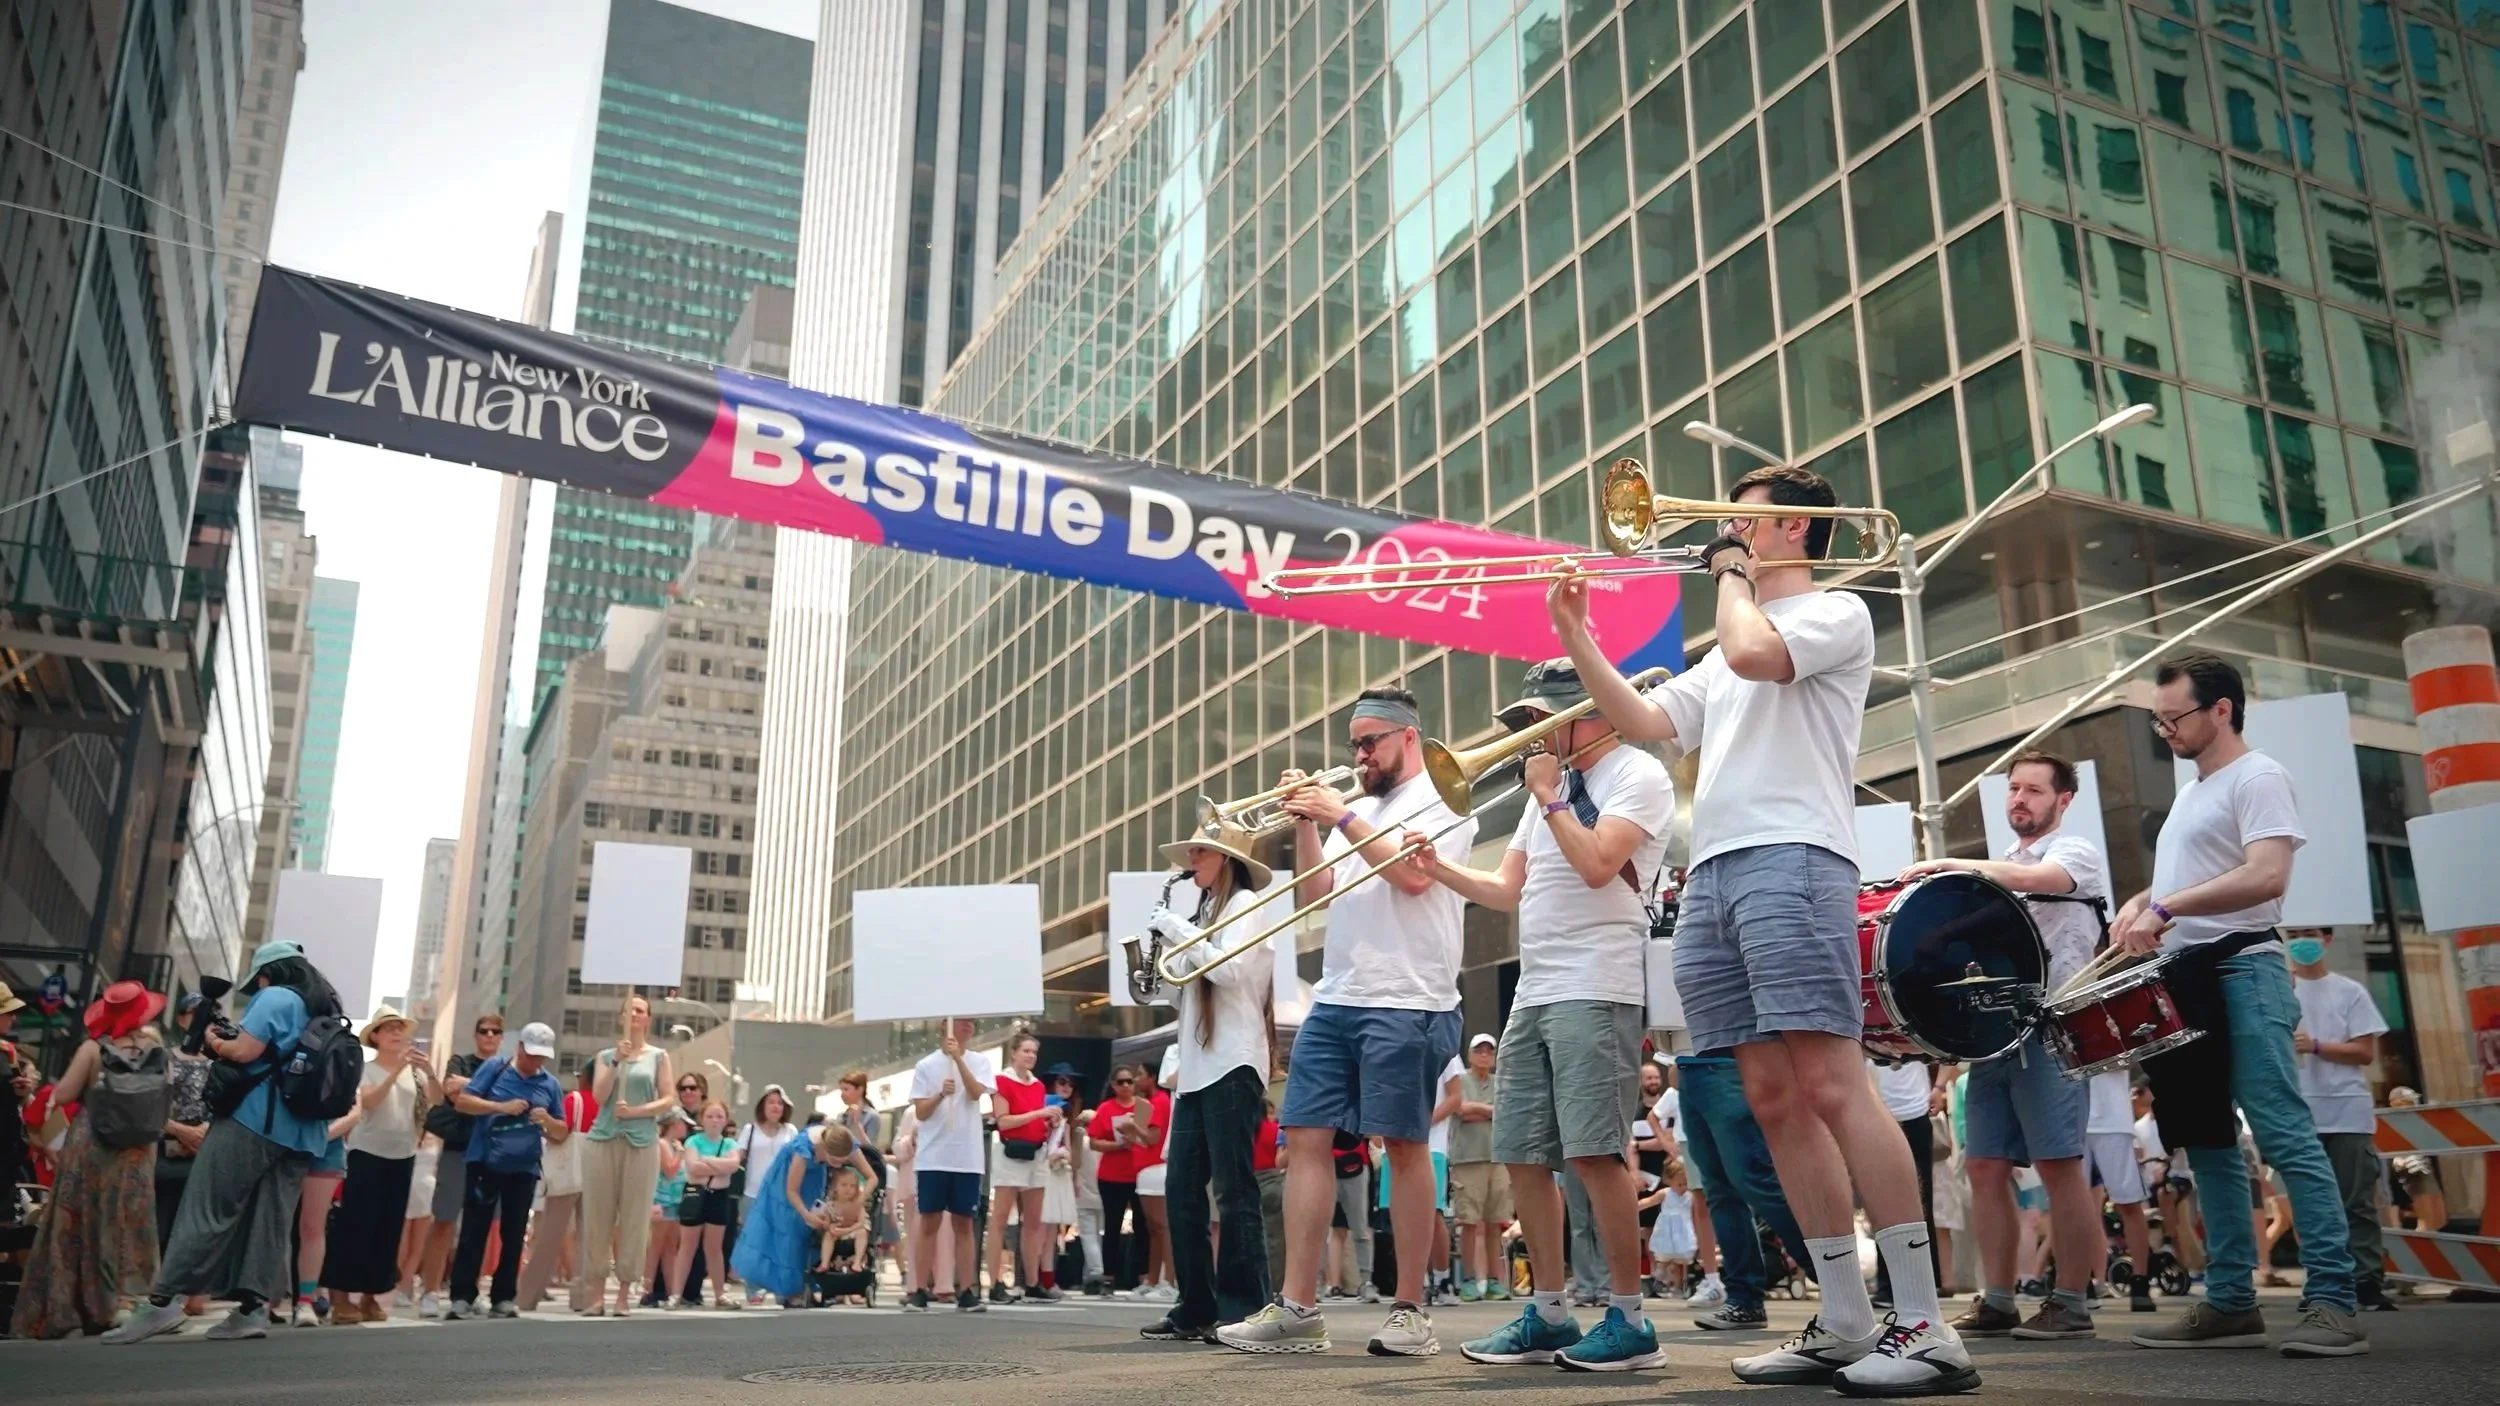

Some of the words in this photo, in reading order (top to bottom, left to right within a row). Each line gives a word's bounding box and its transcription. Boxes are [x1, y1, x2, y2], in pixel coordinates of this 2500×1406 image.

[308, 331, 670, 462] L'Alliance
[489, 350, 570, 393] New
[576, 367, 651, 412] York
[730, 404, 1104, 547] Bastille
[1127, 485, 1297, 599] Day
[1312, 527, 1489, 621] 2024
